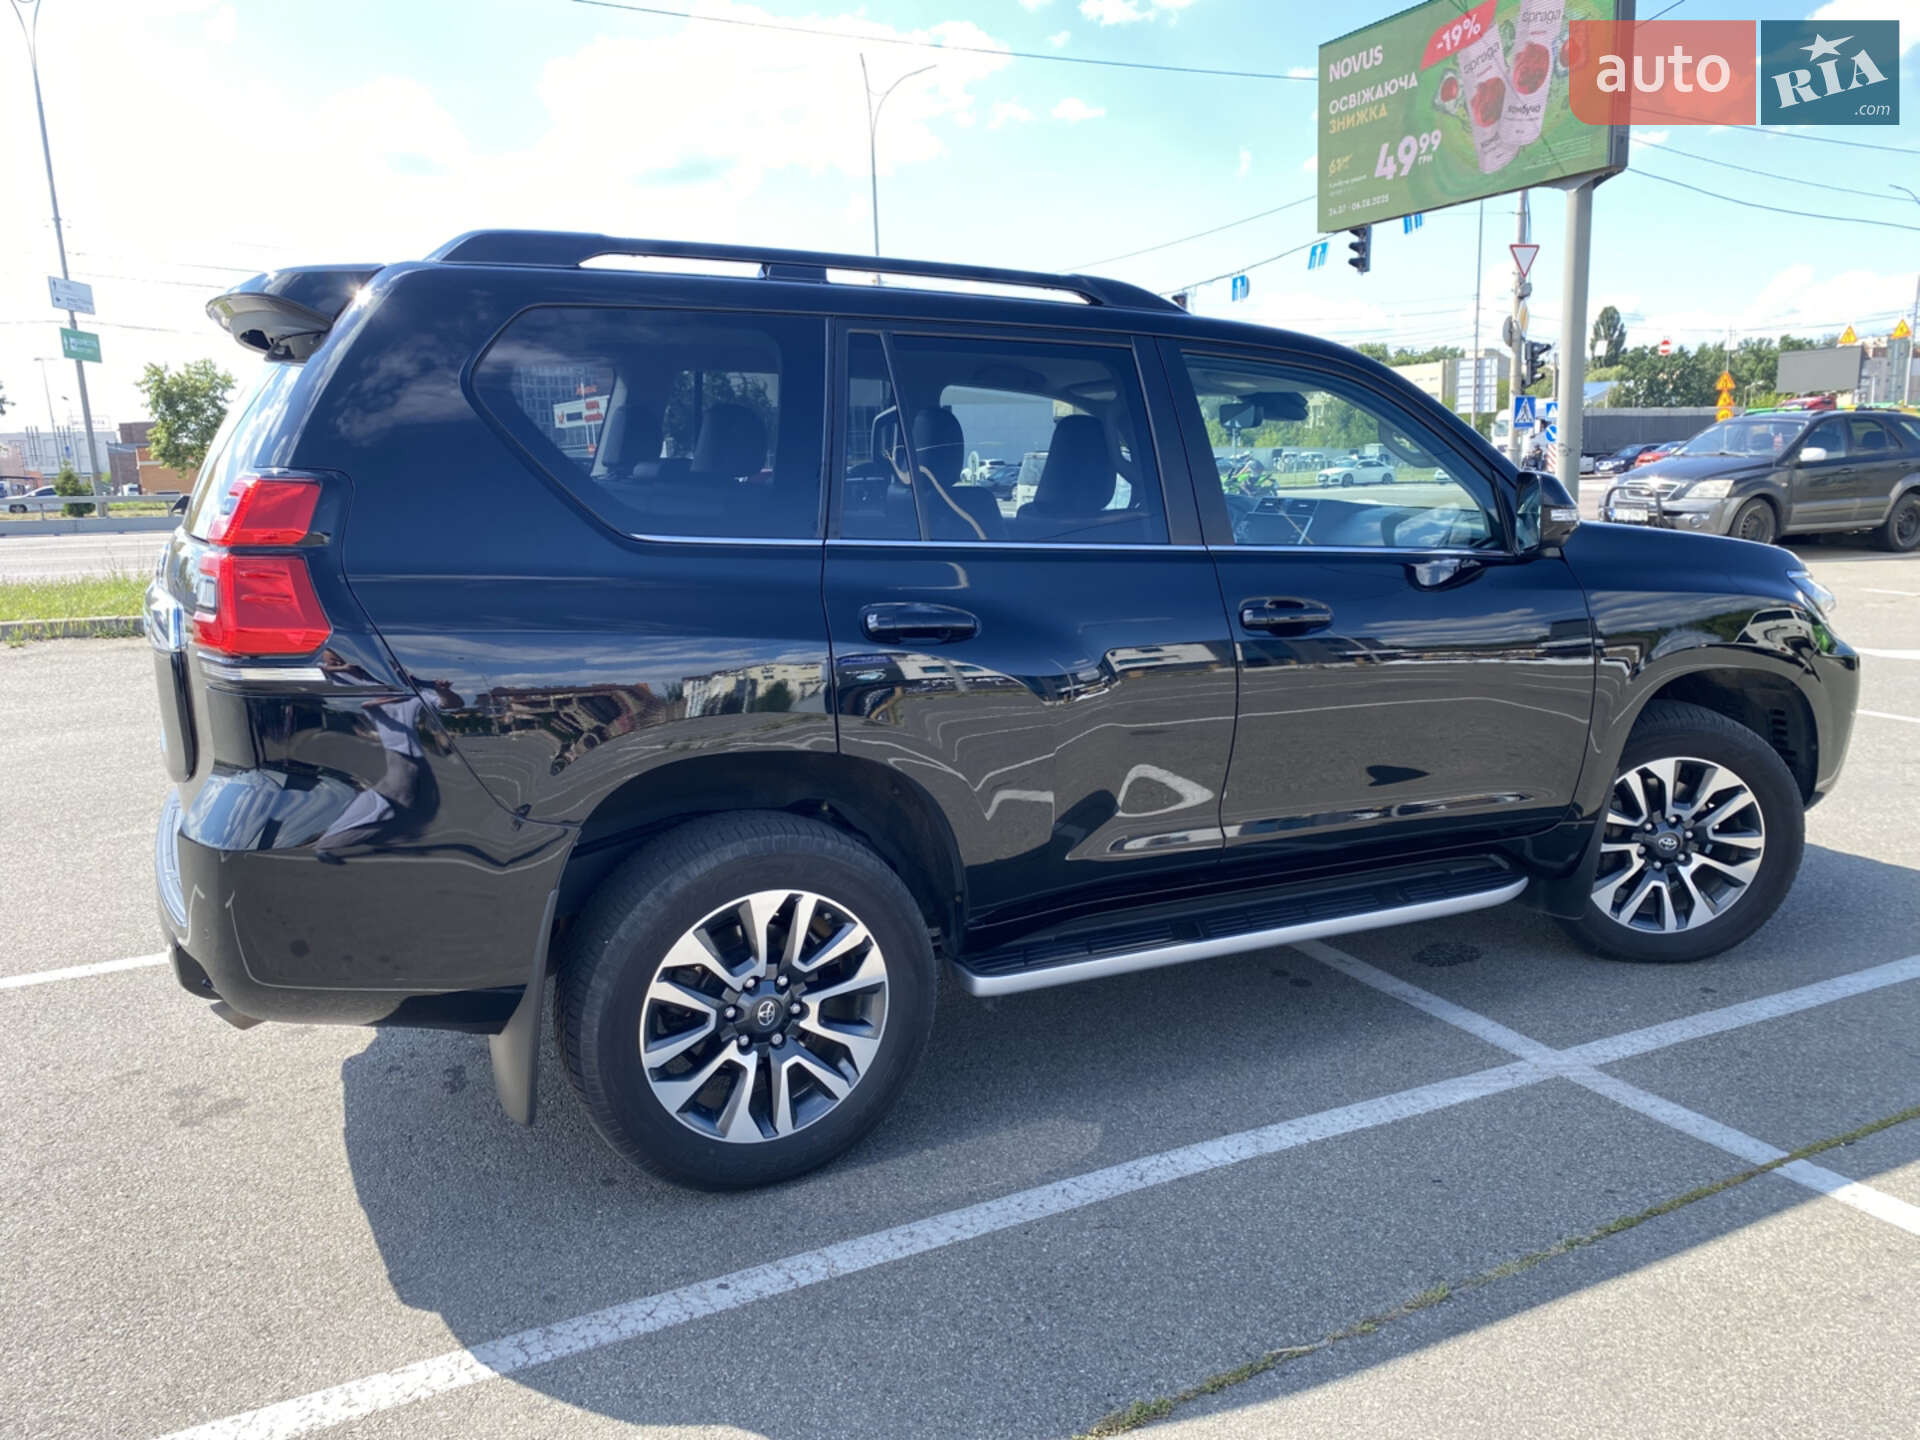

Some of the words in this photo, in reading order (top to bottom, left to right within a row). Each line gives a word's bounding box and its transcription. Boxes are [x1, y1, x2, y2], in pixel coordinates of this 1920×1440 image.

[1436, 13, 1481, 51] -19%
[1329, 44, 1383, 83] NOVUS
[1328, 72, 1418, 114] ОСВІЖАЮЧА
[1328, 103, 1388, 134] ЗНИЖКА
